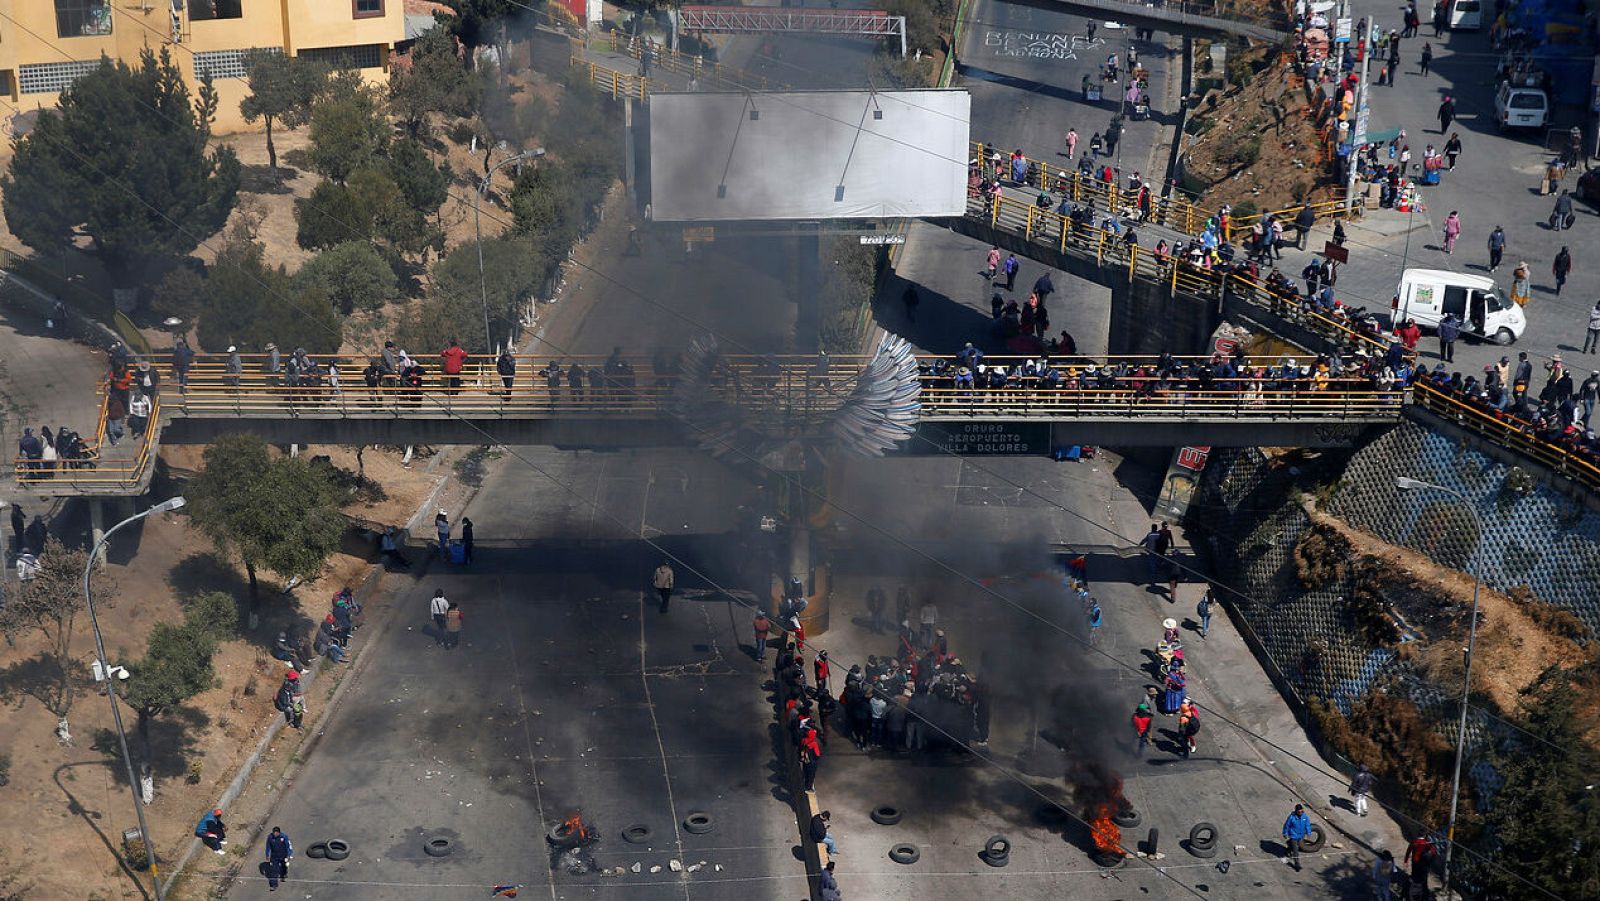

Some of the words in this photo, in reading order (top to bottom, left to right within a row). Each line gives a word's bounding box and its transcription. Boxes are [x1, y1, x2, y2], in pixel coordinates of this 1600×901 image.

[964, 424, 1004, 433] ORURO
[948, 433, 1021, 443] AEROPUERTO
[977, 443, 1029, 452] DOLORES
